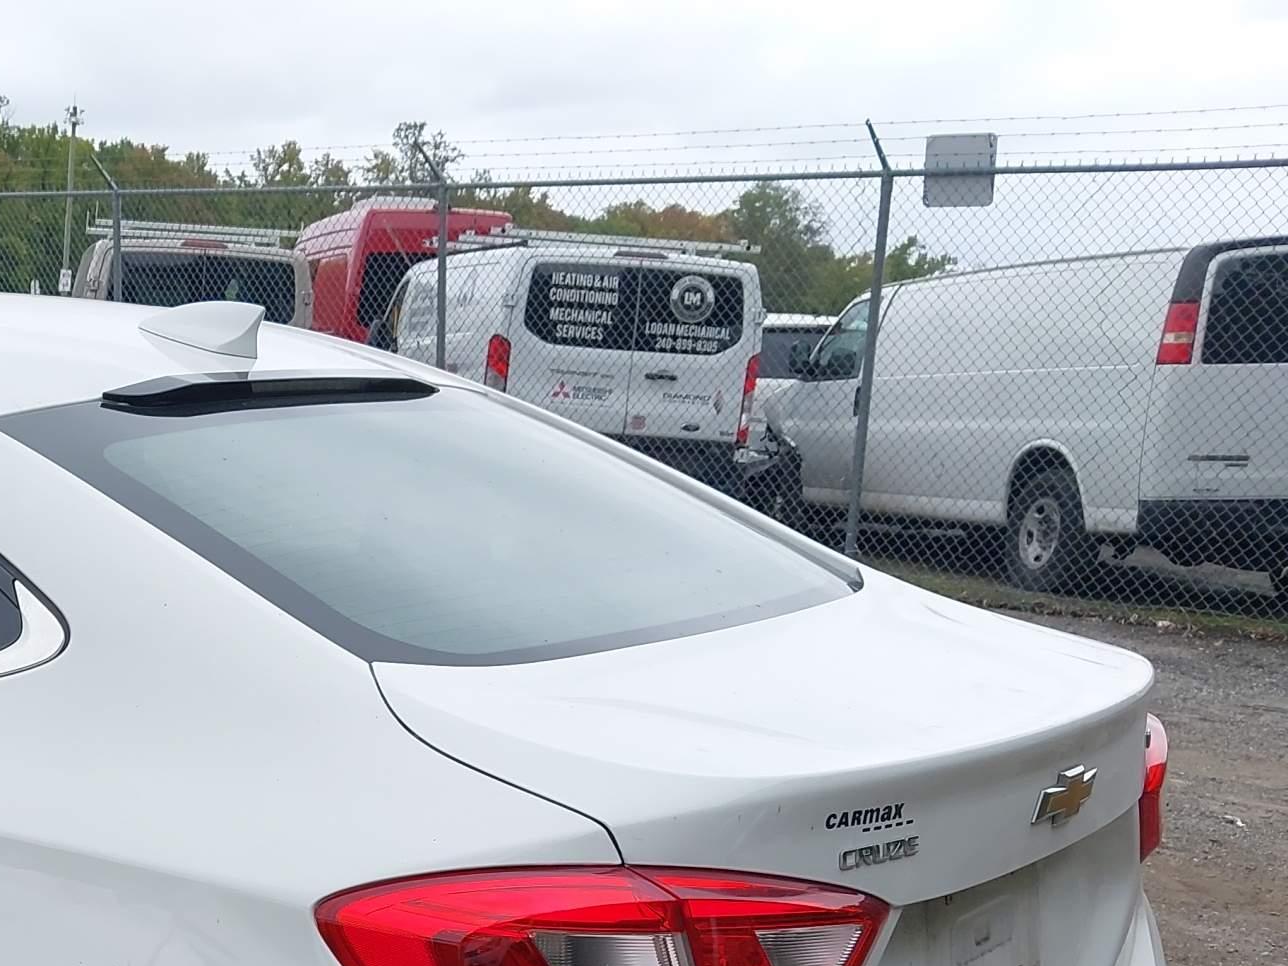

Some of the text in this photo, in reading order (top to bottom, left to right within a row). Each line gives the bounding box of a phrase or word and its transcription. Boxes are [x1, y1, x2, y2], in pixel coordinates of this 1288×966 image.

[552, 272, 619, 288] HEATING & AIR
[549, 286, 618, 306] CONDITIONING
[549, 307, 613, 325] MECHANICAL
[556, 324, 604, 340] SERVICES
[645, 322, 731, 340] LOGAN MECHANICAL
[838, 835, 920, 871] CRUZE
